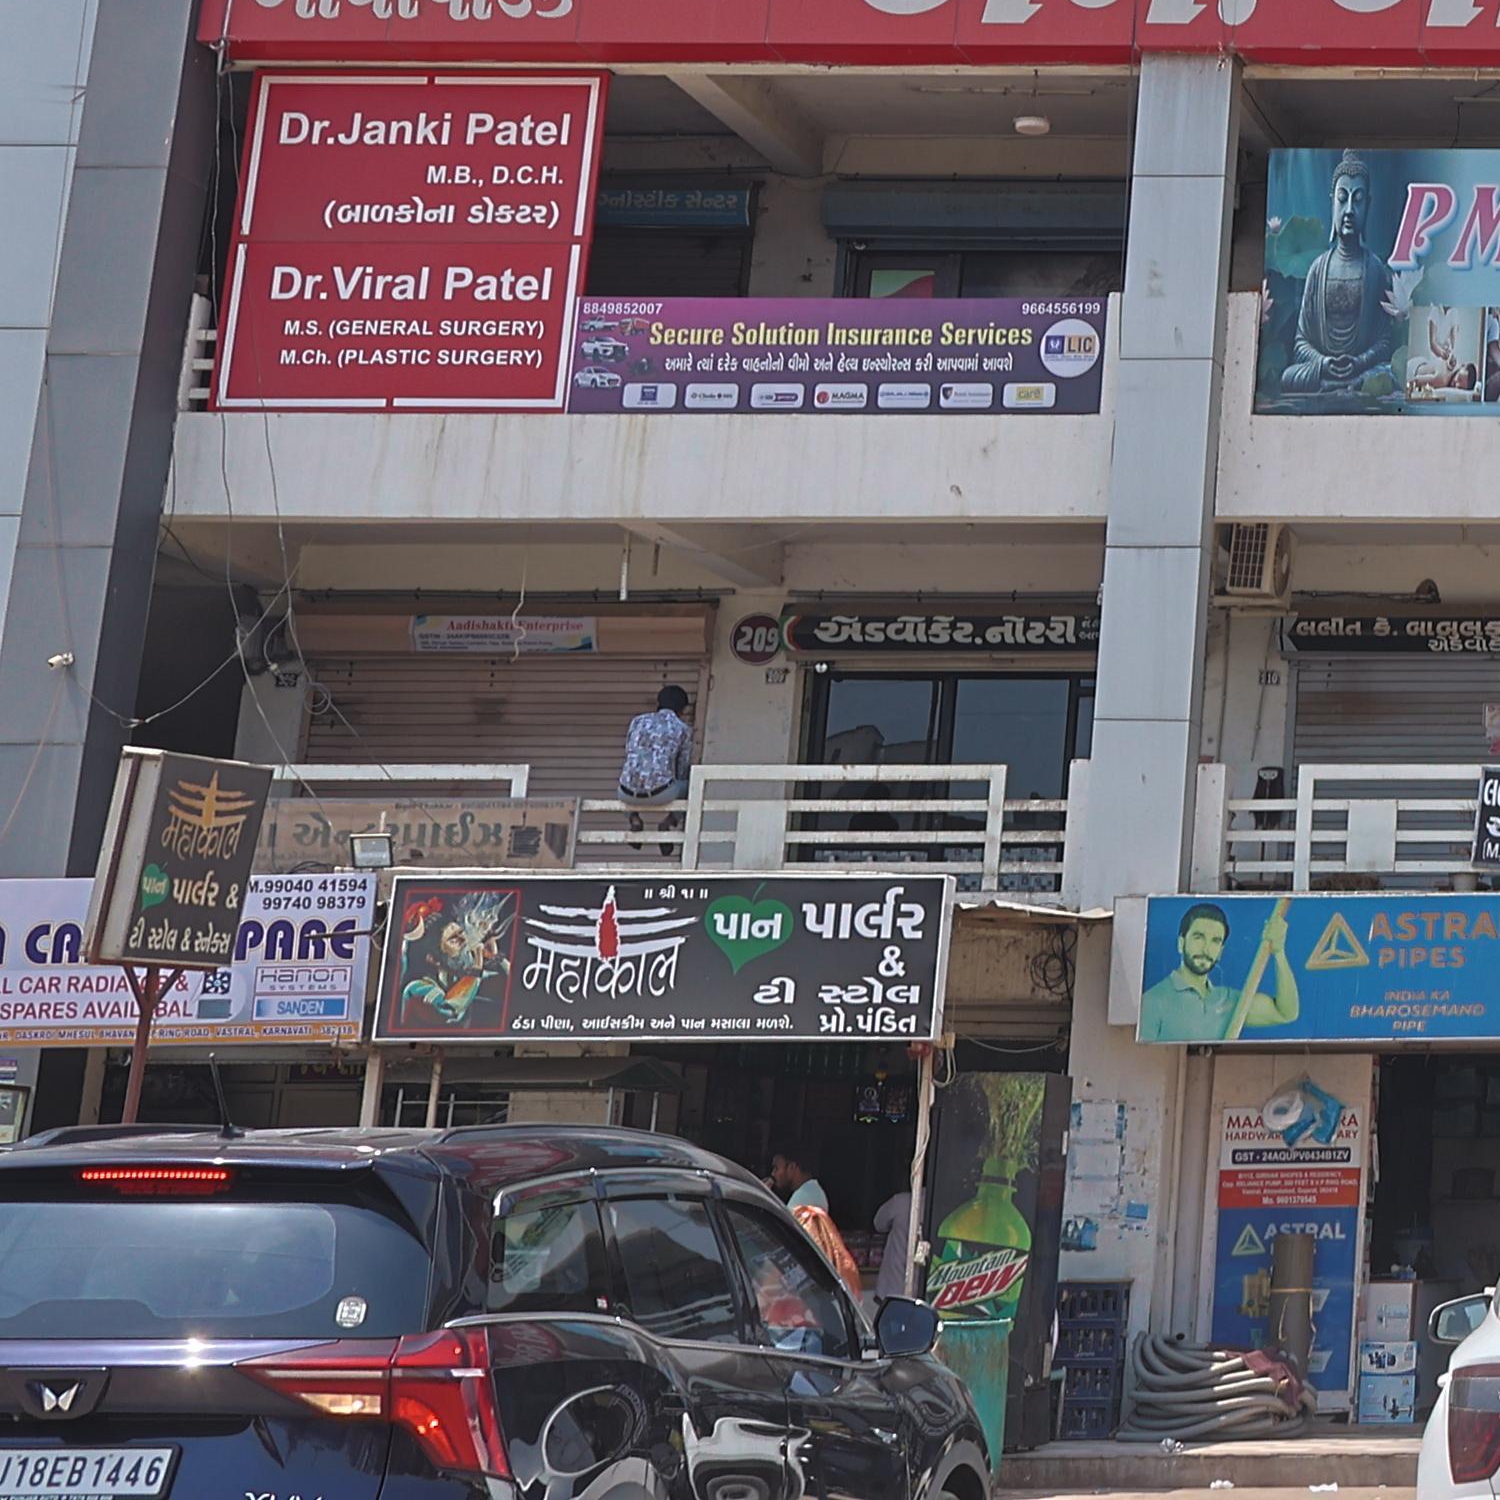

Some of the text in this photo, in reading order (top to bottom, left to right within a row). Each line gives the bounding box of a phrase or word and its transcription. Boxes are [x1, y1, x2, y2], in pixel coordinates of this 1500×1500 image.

[278, 111, 571, 146] Dr.Janki Patel
[426, 165, 564, 188] M.B., D.C.H.
[270, 265, 552, 301] Dr.Viral Patel
[583, 303, 663, 315] 8849852007
[1021, 303, 1101, 315] 9664556199
[284, 319, 545, 340] M.S. (GENERAL SURGERY)
[650, 322, 1033, 346] Secure Solution Insurance Services
[1066, 336, 1094, 353] LIC
[280, 349, 543, 369] M.Ch. (PLASTIC SURGERY)
[736, 626, 779, 651] 209
[142, 870, 239, 908] પાન પાર્લર &
[318, 878, 368, 893] 41594
[262, 896, 366, 911] 99740 98379
[713, 887, 925, 942] પાન પાર્લર
[25, 919, 356, 964] CA PARE
[128, 917, 145, 949] ટી
[879, 946, 907, 978] &
[1379, 947, 1466, 968] PIPES
[19, 975, 189, 993] CAR &
[261, 968, 347, 983] Hanon
[752, 976, 922, 1006] ટી સ્ટોલ
[0, 1002, 78, 1020] SPARES
[277, 1001, 324, 1015] SANDEN
[1350, 1003, 1485, 1018] BHAROSEMAND
[512, 1014, 536, 1032] ઠંડા
[650, 1015, 676, 1032] અને
[681, 1016, 706, 1031] પાન
[711, 1015, 751, 1032] મસાલા
[1227, 1116, 1264, 1129] MAA
[1235, 1152, 1254, 1161] GST
